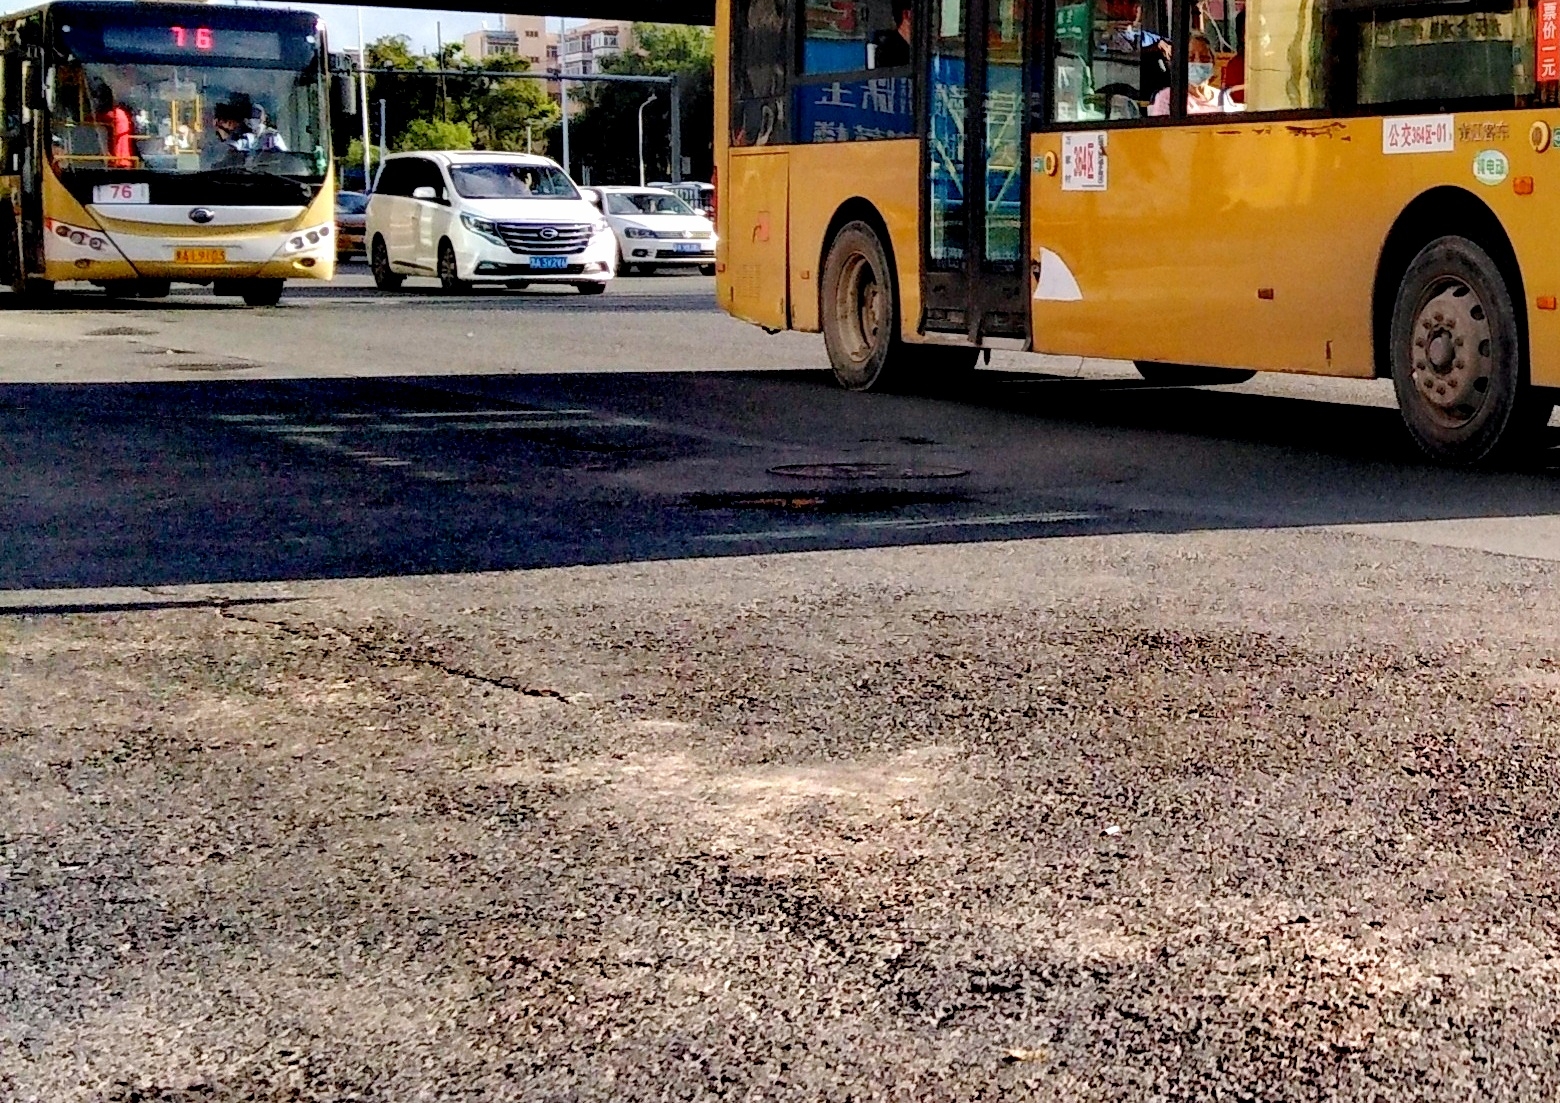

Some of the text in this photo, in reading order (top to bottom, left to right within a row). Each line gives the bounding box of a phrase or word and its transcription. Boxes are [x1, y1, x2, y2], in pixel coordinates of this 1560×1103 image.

[1542, 1, 1558, 77] 票价一元
[110, 185, 133, 199] 76
